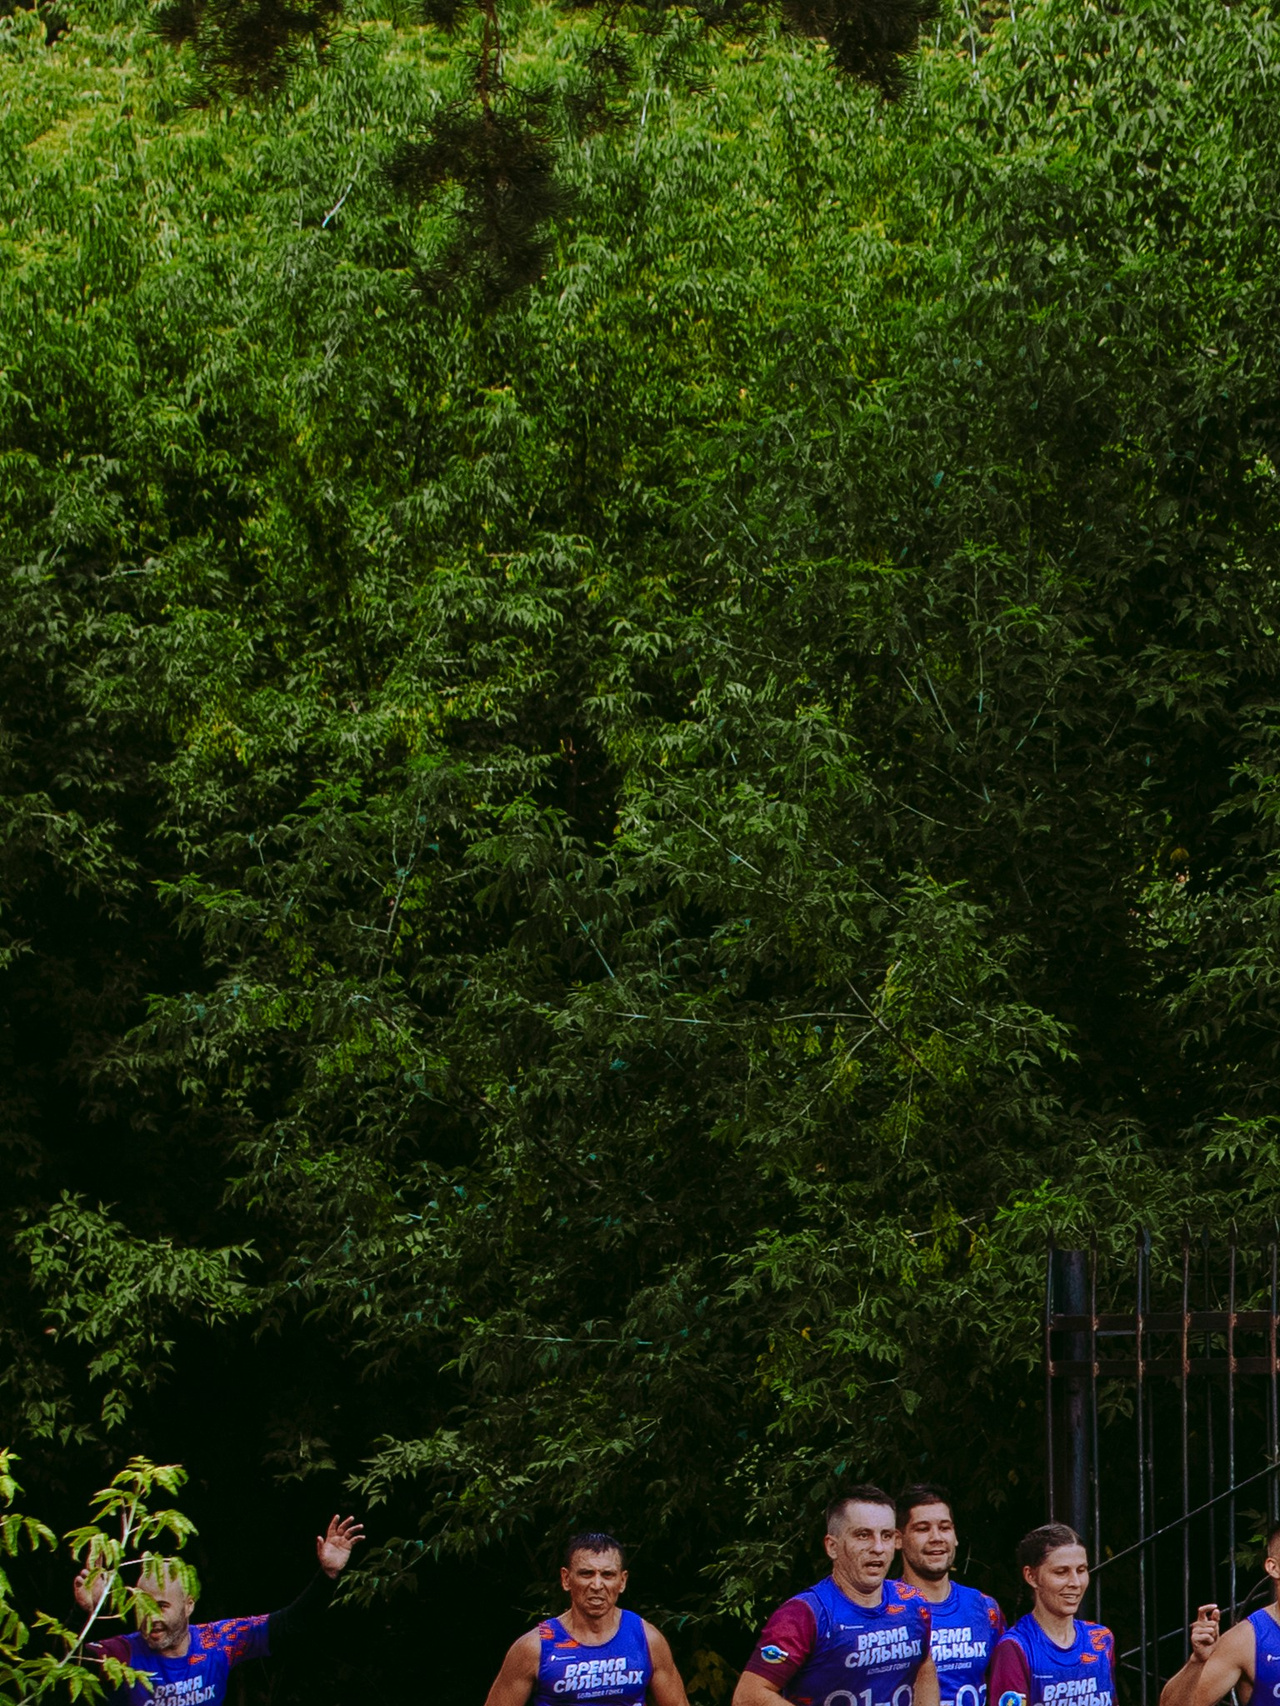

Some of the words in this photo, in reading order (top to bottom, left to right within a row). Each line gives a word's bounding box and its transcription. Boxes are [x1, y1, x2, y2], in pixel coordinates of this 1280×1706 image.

[857, 1626, 909, 1651] ВРЕМЯ
[930, 1627, 972, 1646] РЕМЯ
[844, 1639, 922, 1668] СИЛЬНЫХ
[931, 1641, 987, 1661] ЛЬНЫХ
[564, 1657, 627, 1679] ВРЕМЯ
[154, 1675, 203, 1699] ВРЕМЯ
[553, 1670, 644, 1693] СИЛЬНЫХ
[1043, 1677, 1098, 1701] ВРЕМЯ
